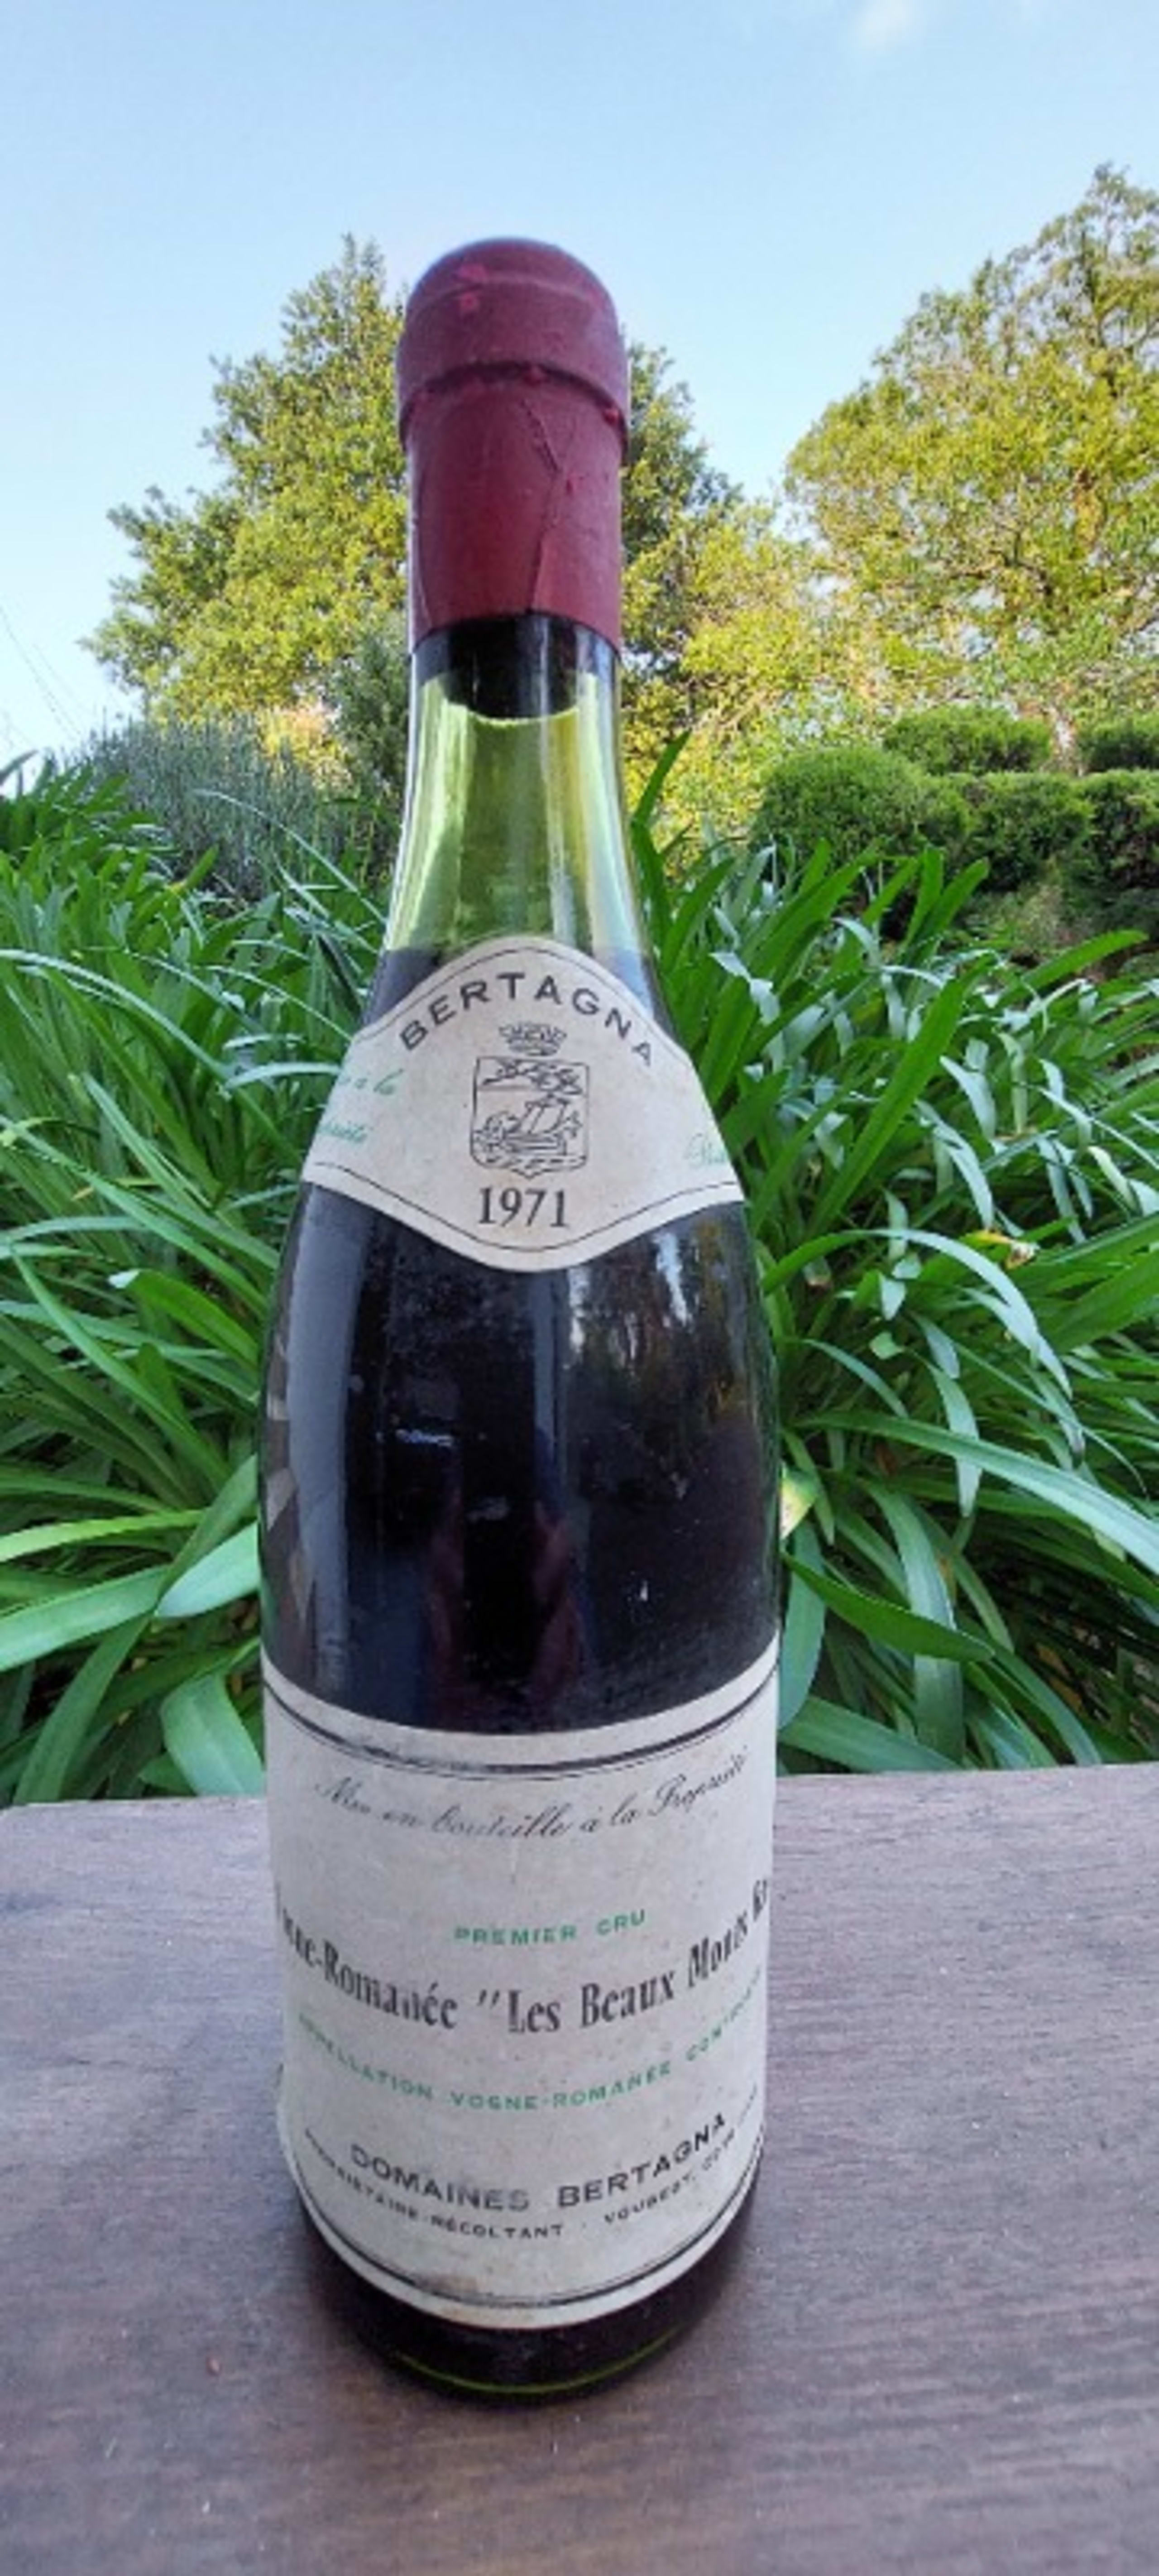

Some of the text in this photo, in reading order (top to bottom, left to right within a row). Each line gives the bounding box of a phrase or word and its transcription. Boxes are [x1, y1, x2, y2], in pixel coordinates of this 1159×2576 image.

[399, 972, 653, 1067] BERTAGNA
[477, 1186, 571, 1228] 1971
[455, 1909, 645, 1946] PREMIER CRU
[580, 1970, 676, 2029] Beaux
[350, 2112, 725, 2212] DOMAINES BERTAGNA
